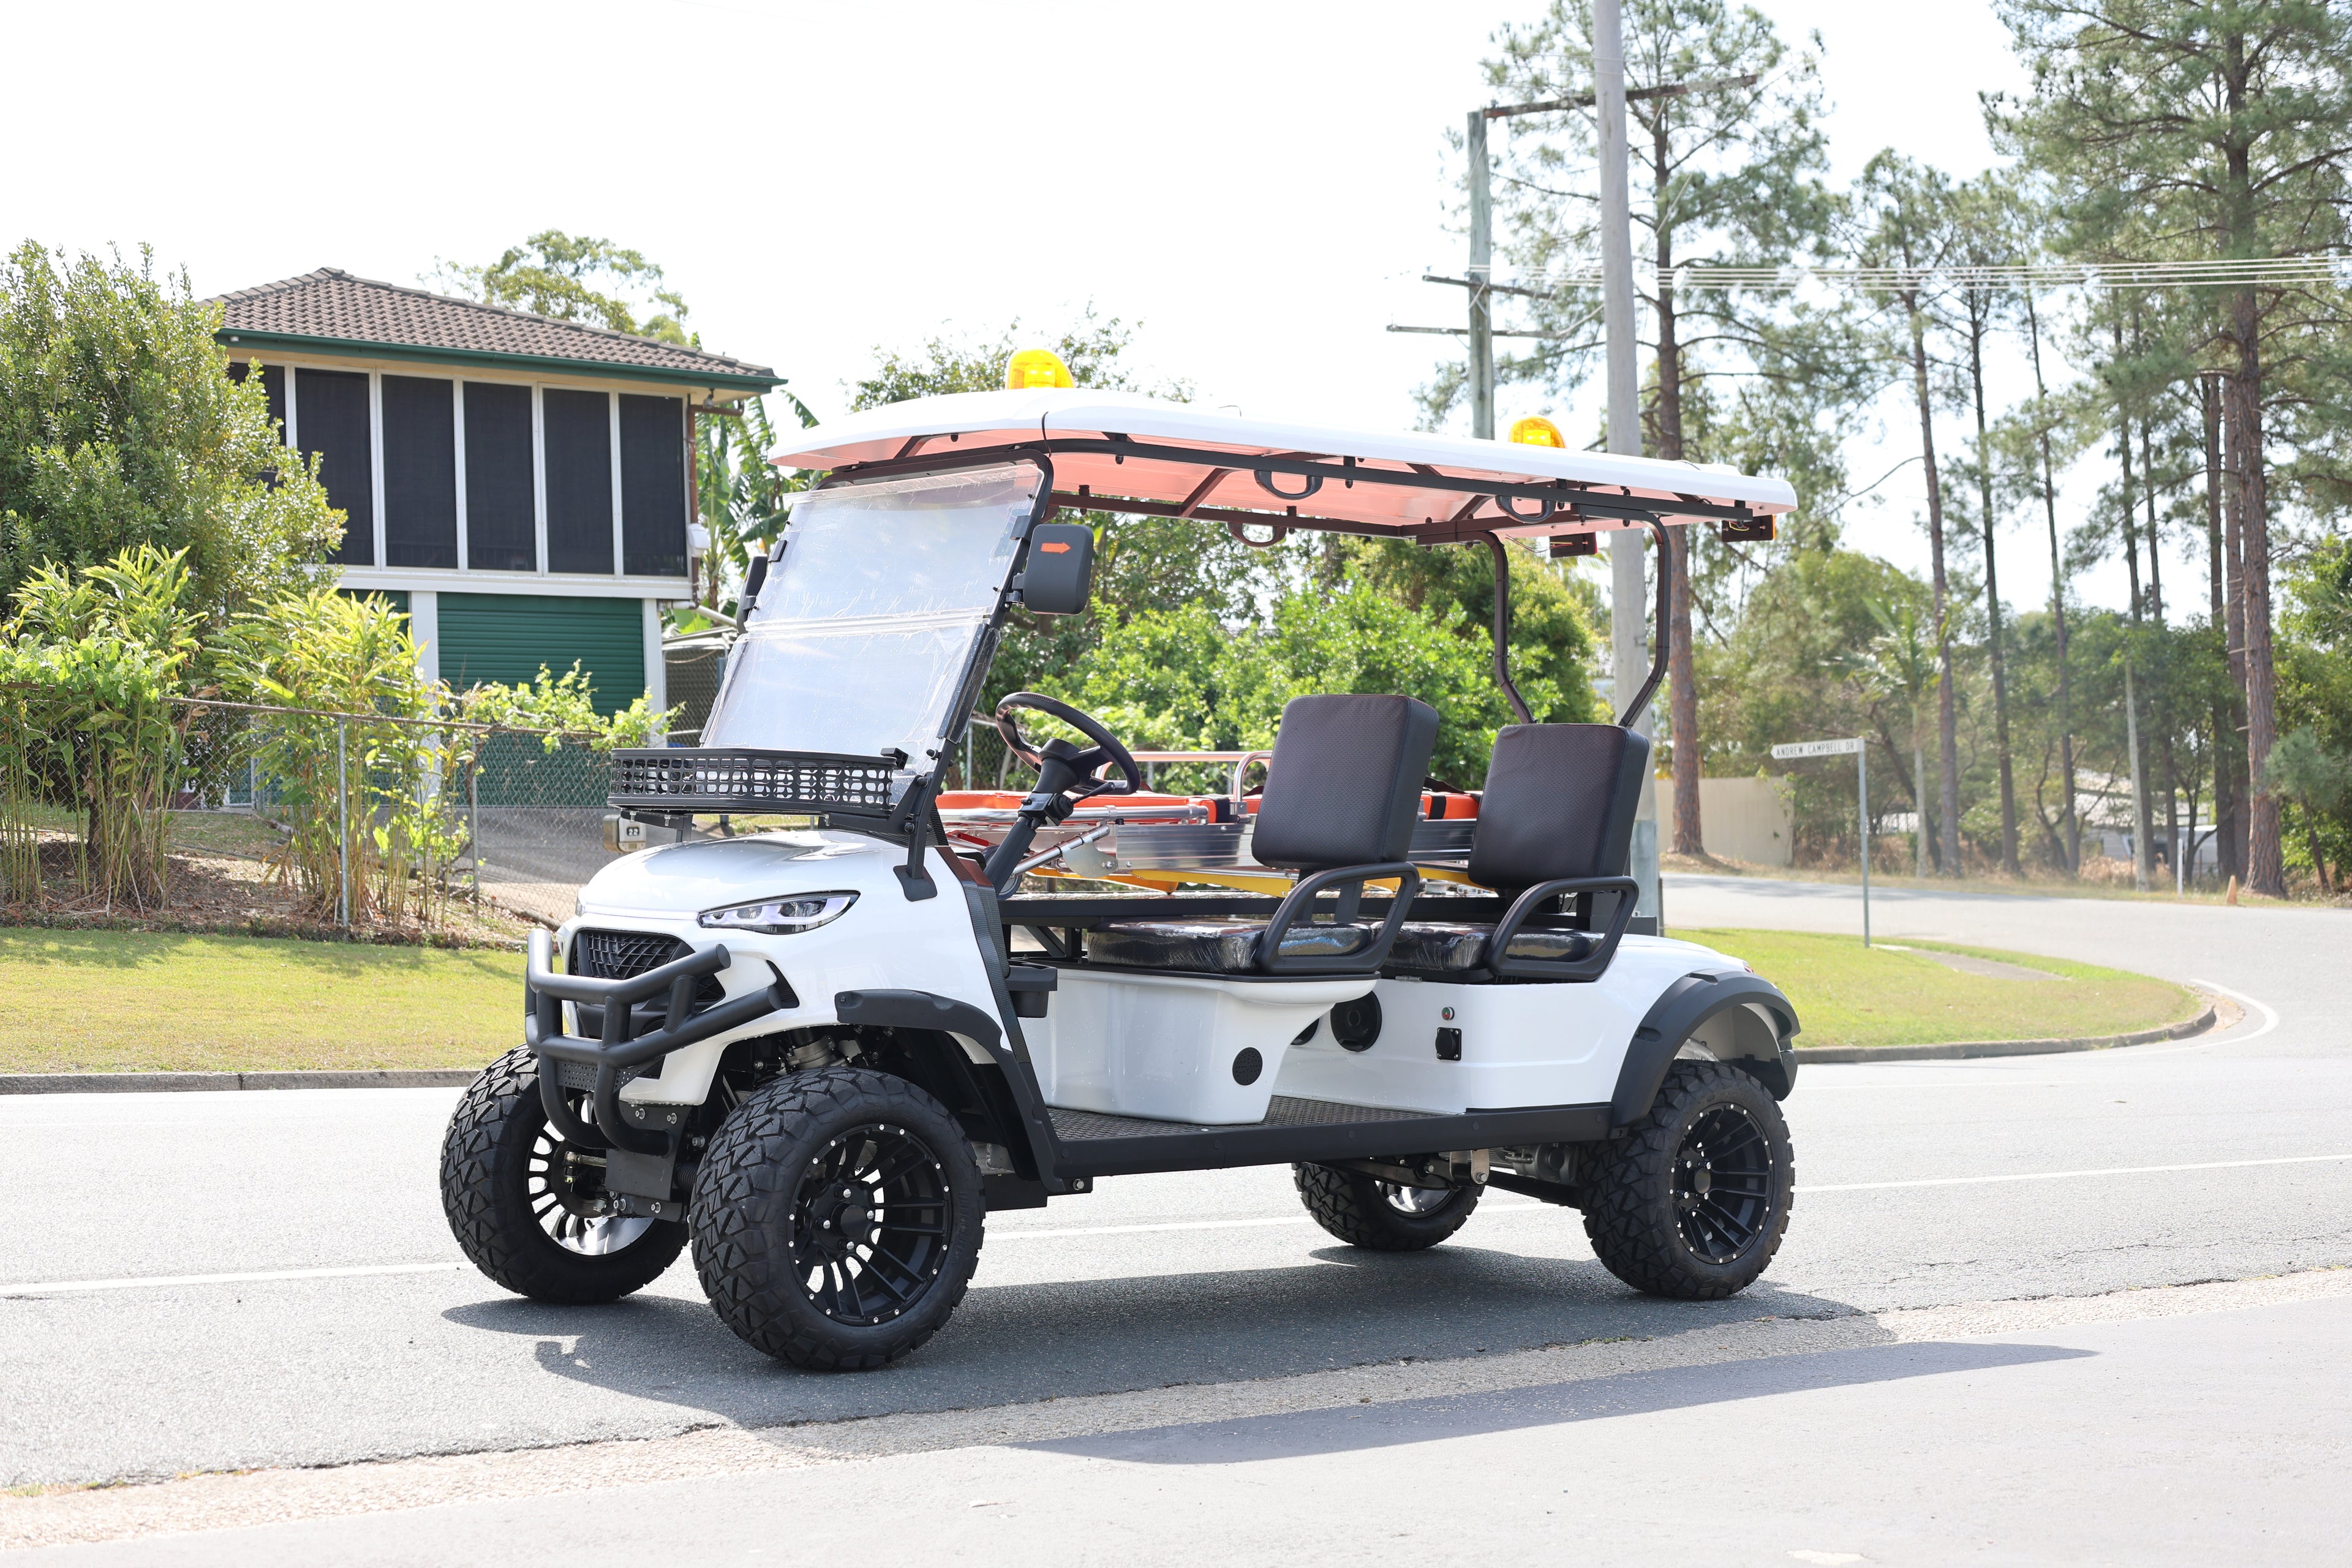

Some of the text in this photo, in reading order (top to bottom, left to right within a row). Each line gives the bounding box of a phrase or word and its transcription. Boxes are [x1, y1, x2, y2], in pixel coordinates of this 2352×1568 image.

[1776, 741, 1855, 757] ANDREW CAMPBELL DR
